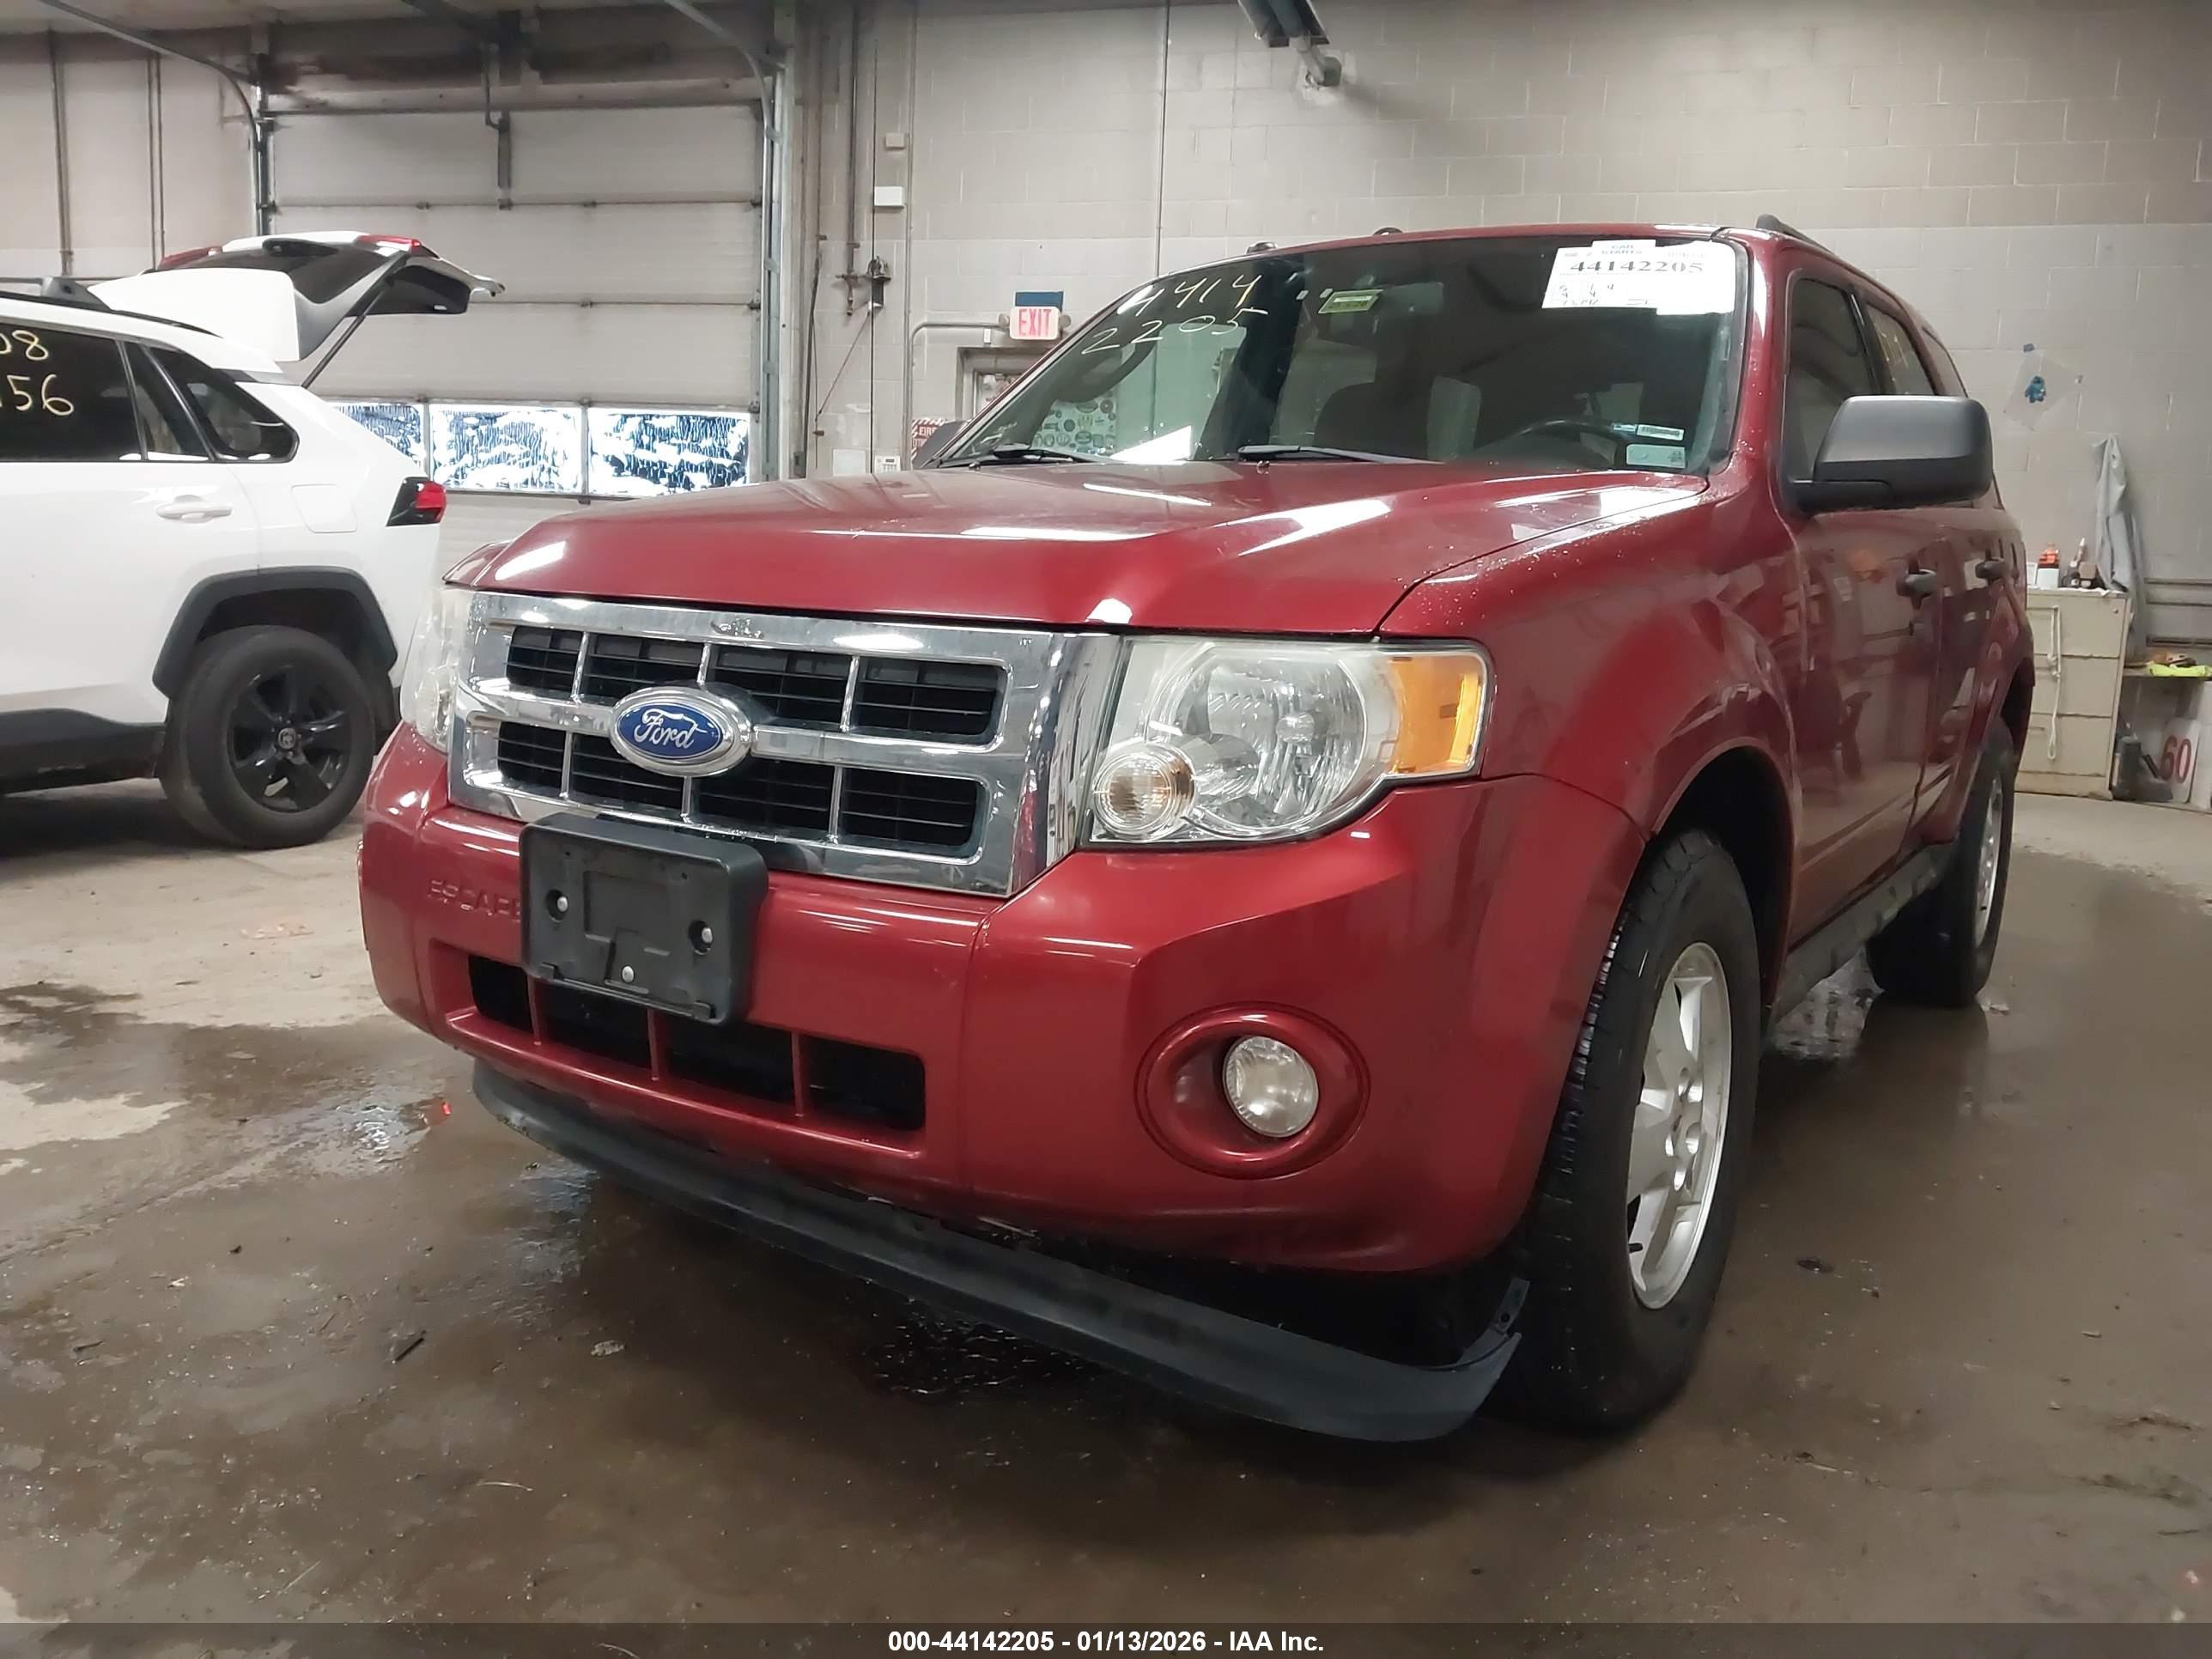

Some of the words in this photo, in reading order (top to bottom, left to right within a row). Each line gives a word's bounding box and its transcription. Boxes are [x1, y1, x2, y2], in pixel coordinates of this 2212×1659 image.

[1570, 260, 1705, 273] 44142205
[1018, 308, 1052, 337] EXIT
[1081, 306, 1269, 354] 2205
[633, 708, 708, 749] Ford
